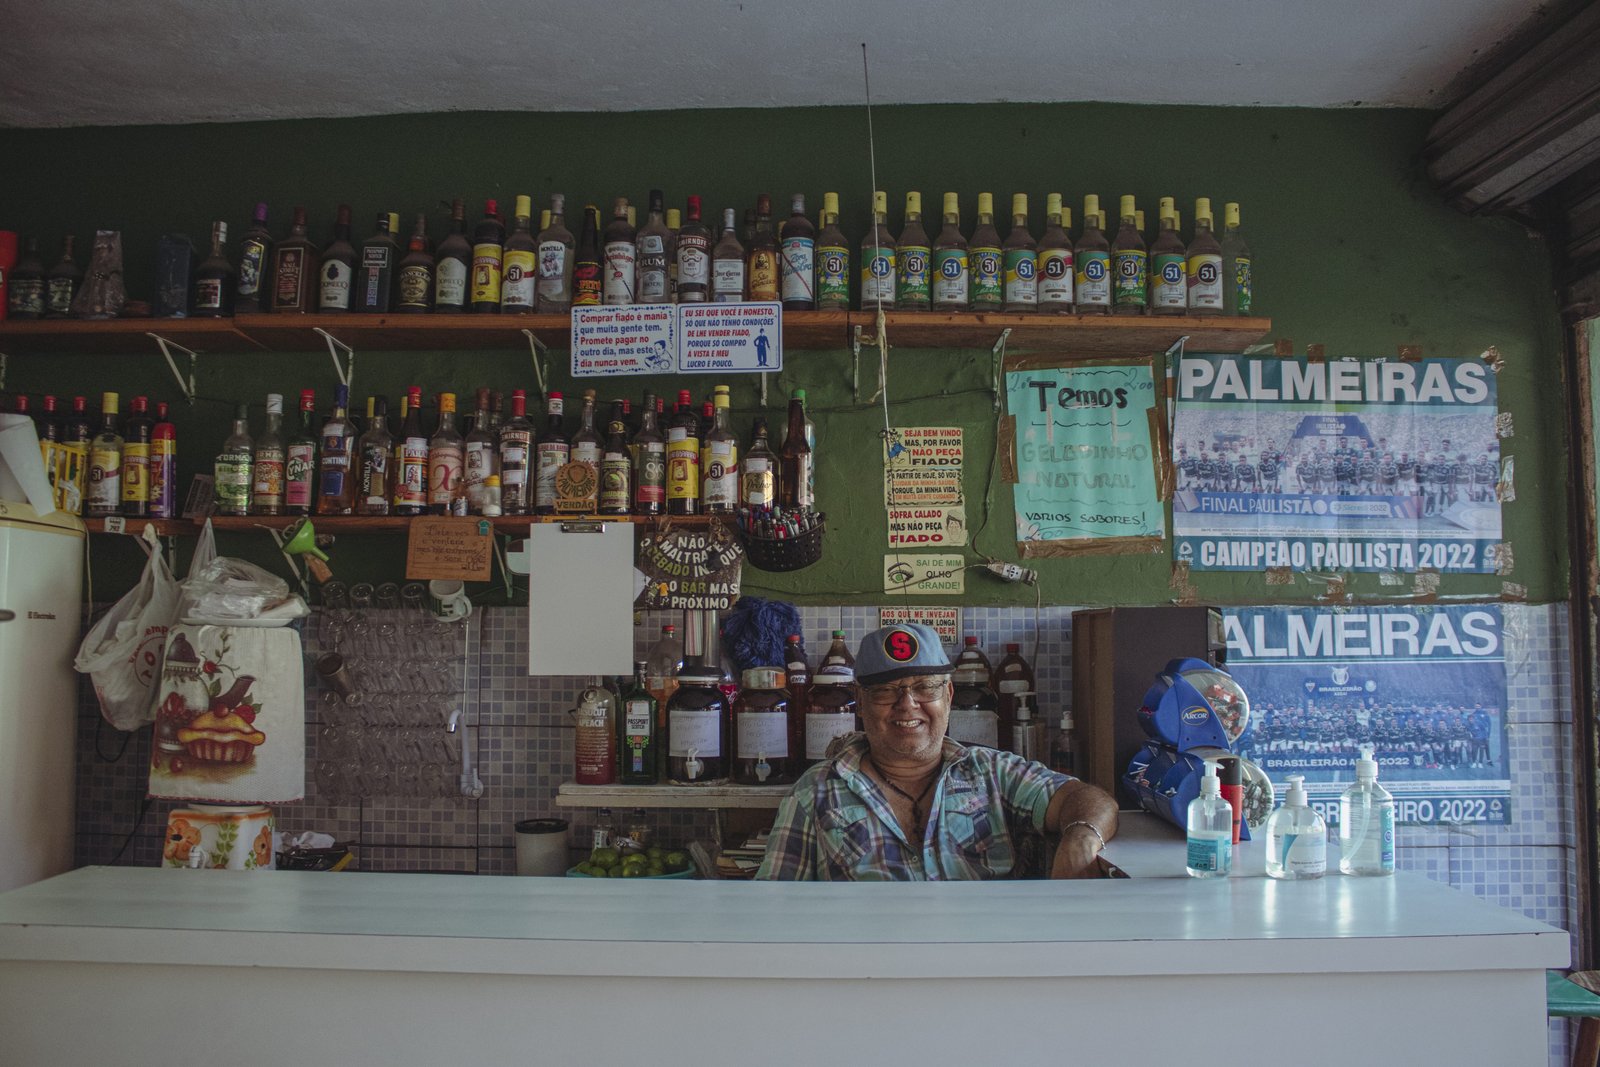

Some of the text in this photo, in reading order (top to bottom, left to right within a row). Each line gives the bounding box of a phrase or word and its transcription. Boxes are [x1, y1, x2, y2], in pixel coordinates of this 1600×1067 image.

[640, 258, 665, 267] RUM
[829, 259, 840, 271] 51
[872, 260, 886, 273] 51
[910, 258, 921, 270] 51
[944, 262, 958, 274] 51
[984, 260, 995, 273] 51
[1048, 262, 1061, 274] 51
[1124, 262, 1135, 274] 51
[511, 268, 520, 279] 51
[1020, 263, 1032, 275] 51
[1088, 264, 1102, 276] 51
[1165, 267, 1179, 279] 51
[1200, 266, 1213, 278] 51
[580, 314, 613, 324] Comprar
[615, 312, 635, 322] fiado
[644, 311, 668, 320] mania
[694, 309, 704, 317] SEI
[706, 309, 719, 317] QUE
[743, 308, 774, 316] HONESTO.
[694, 319, 706, 327] QUE
[708, 317, 720, 326] NÃO
[721, 318, 741, 326] TENHO
[580, 322, 662, 336] que muita gente tem.
[708, 329, 730, 337] VENDER
[580, 337, 613, 345] Promete
[615, 337, 638, 346] pagar
[687, 340, 710, 348] PORQUE
[721, 339, 746, 347] COMPRO
[580, 346, 654, 357] outro dia, mas este
[693, 350, 710, 358] VISTA
[580, 359, 592, 368] dia
[595, 359, 618, 367] nunca
[687, 360, 706, 368] LUCRO
[1180, 358, 1488, 403] PALMEIRAS
[1029, 381, 1128, 412] Temos
[912, 447, 961, 457] NÃO PEÇA
[92, 470, 101, 480] 51
[287, 458, 315, 480] CYNAR
[711, 465, 723, 478] 51
[363, 461, 371, 492] MONTILLA
[559, 476, 595, 498] PALMEIRAS
[557, 500, 594, 509] VERDÃO
[1202, 498, 1248, 513] FINAL
[1250, 497, 1327, 515] PAULISTÃO
[890, 510, 942, 519] SOFRA CALADO
[890, 521, 942, 532] MAS NÃO PEÇA
[678, 534, 705, 549] NÃO
[890, 534, 943, 542] FIADO
[720, 542, 743, 566] QUE
[1201, 540, 1476, 568] CAMPEÃO PAULISTA 2022
[926, 570, 951, 578] OLHO
[670, 581, 677, 592] O
[681, 581, 706, 593] BAR
[1223, 612, 1498, 657] ALMEIRAS
[890, 630, 911, 659] S
[1182, 712, 1208, 720] ARCOR
[1268, 756, 1347, 768] BRASILEIRÃO
[1380, 758, 1410, 766] 2022
[1317, 800, 1486, 822] BREIRO 2022
